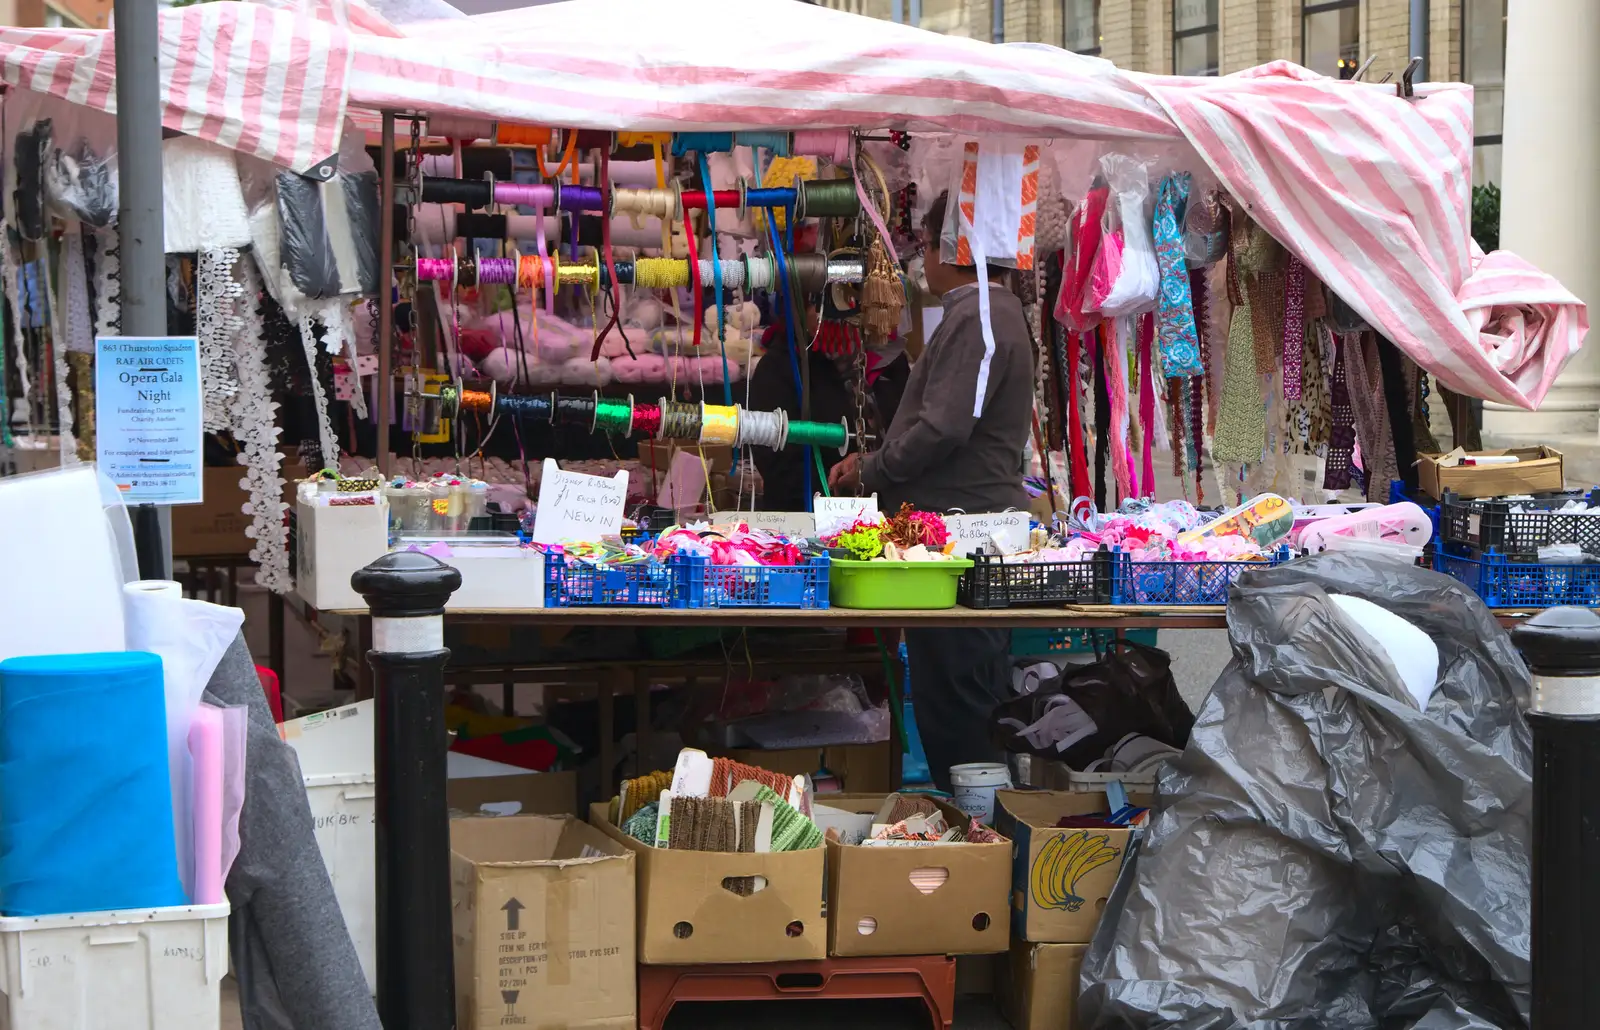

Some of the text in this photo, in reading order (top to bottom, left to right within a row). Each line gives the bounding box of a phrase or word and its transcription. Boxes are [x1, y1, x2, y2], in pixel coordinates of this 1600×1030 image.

[103, 344, 193, 353] 863 (Thurston) Squadron
[116, 357, 184, 365] RAF AIR CADETS
[119, 371, 183, 386] Opera Gala
[137, 390, 171, 404] Night
[553, 473, 583, 486] DISNEY
[563, 509, 614, 527] NEW IN
[956, 518, 962, 530] 3
[993, 517, 1020, 526] WIRED
[959, 529, 991, 539] RIBBON
[500, 931, 527, 940] SIDE UP
[498, 944, 515, 953] ITEM
[589, 948, 602, 957] PVC
[603, 946, 620, 956] SEAT
[526, 966, 538, 974] PCS
